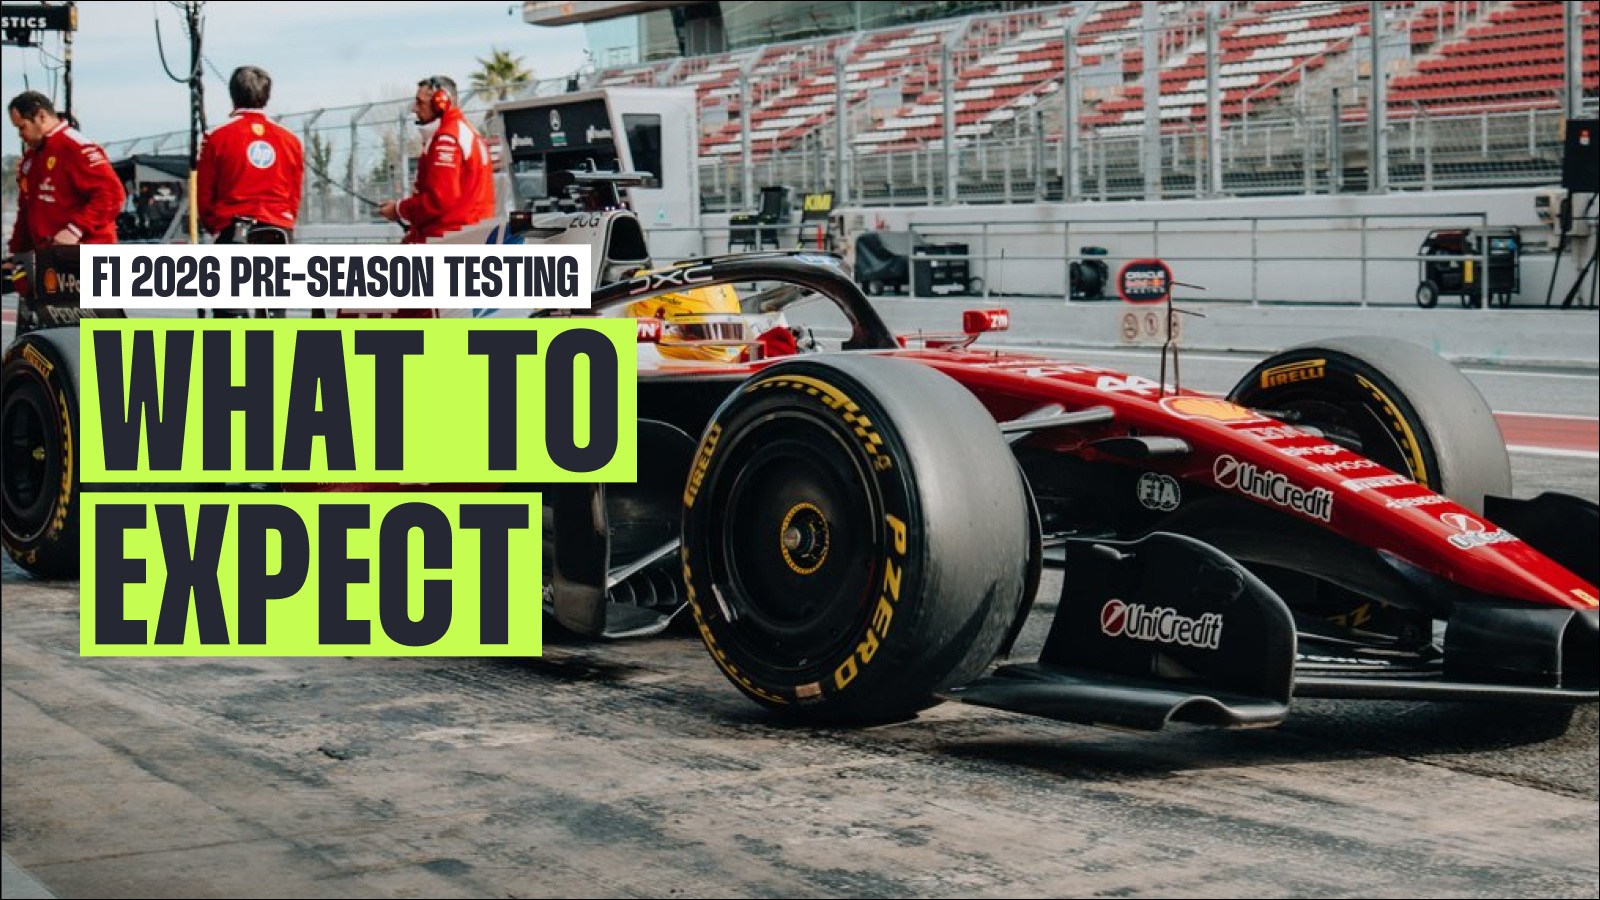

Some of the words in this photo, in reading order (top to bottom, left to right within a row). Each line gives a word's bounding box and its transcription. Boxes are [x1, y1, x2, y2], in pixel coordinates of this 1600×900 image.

[1261, 358, 1326, 390] PIRELLI
[1140, 478, 1177, 505] FIA
[1238, 463, 1334, 522] UniCredit
[1125, 603, 1223, 649] UniCredit
